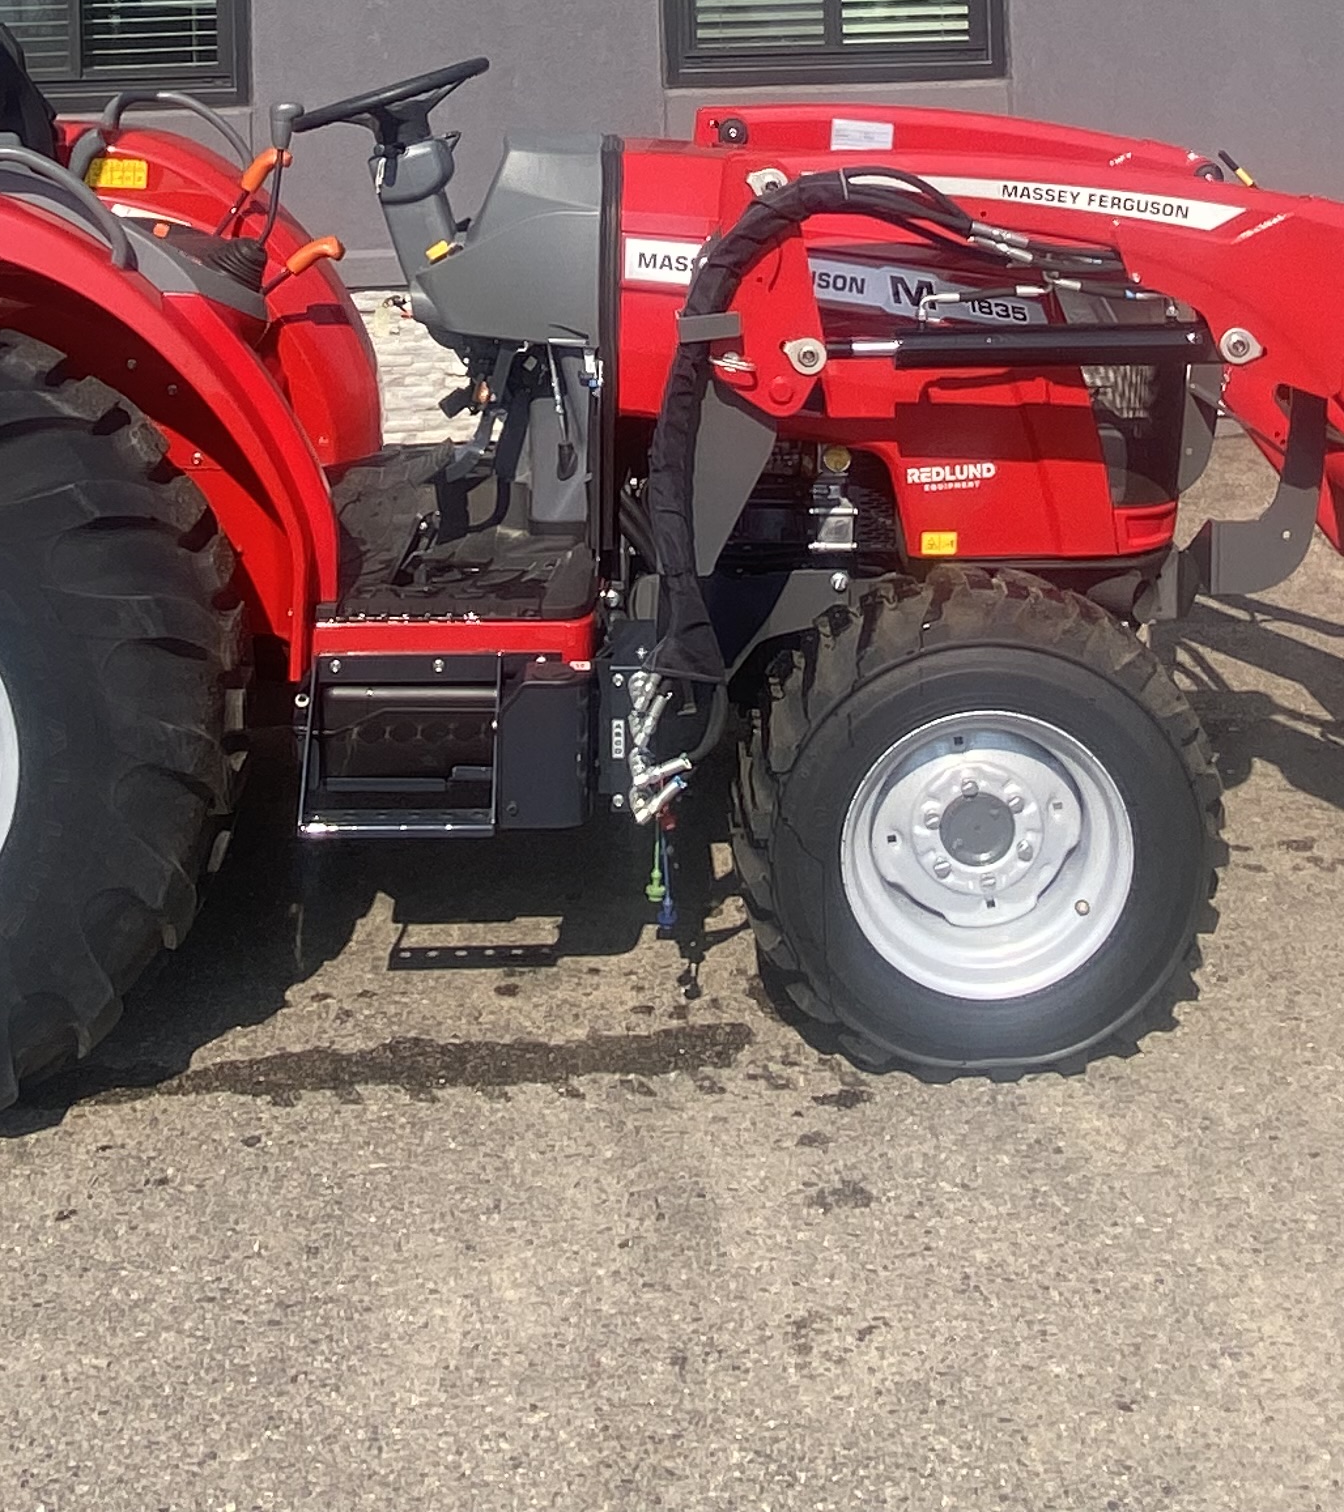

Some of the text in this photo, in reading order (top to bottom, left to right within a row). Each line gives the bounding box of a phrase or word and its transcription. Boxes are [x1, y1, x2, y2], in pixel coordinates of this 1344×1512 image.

[1002, 184, 1190, 220] MASSEY FERGUSON
[906, 463, 996, 484] REDLUND
